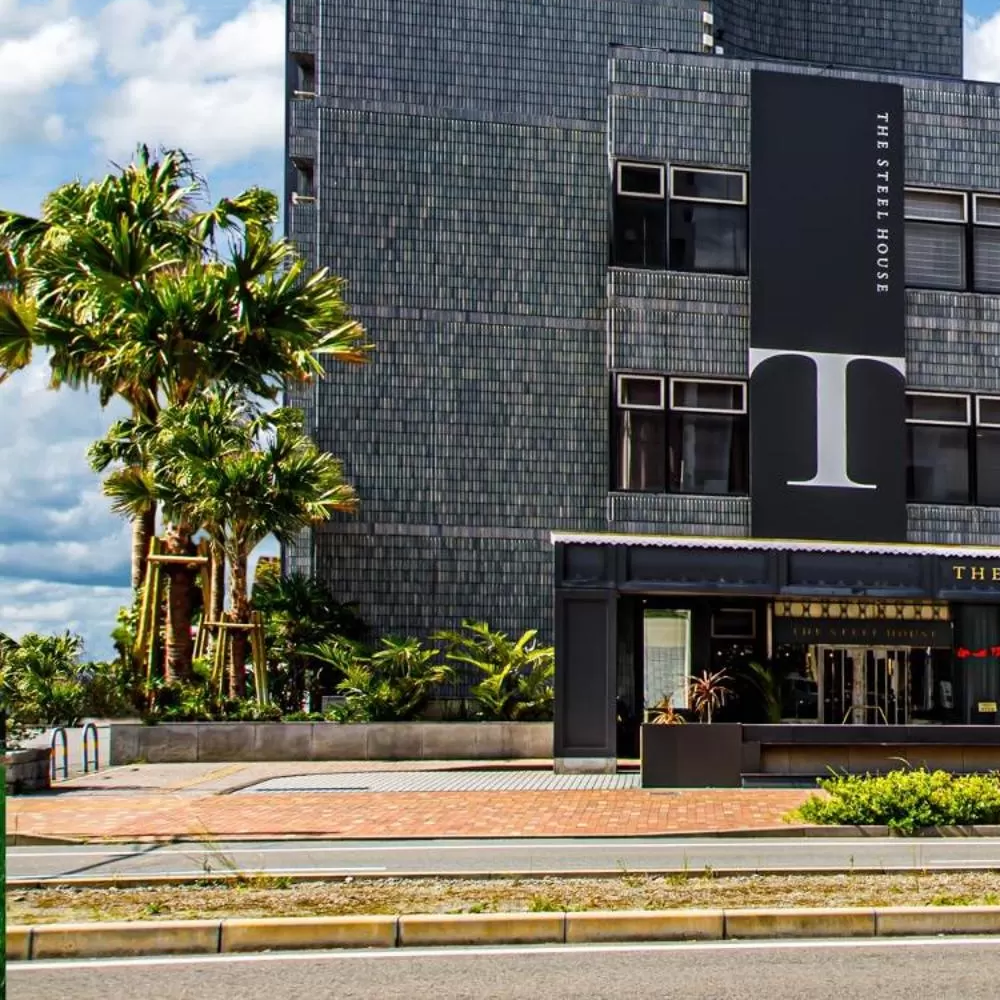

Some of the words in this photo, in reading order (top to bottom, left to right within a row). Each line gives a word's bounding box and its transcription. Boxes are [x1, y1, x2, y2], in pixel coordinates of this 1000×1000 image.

[876, 112, 889, 149] THE
[876, 158, 889, 220] STEEL
[876, 228, 889, 292] HOUSE
[749, 347, 906, 489] T
